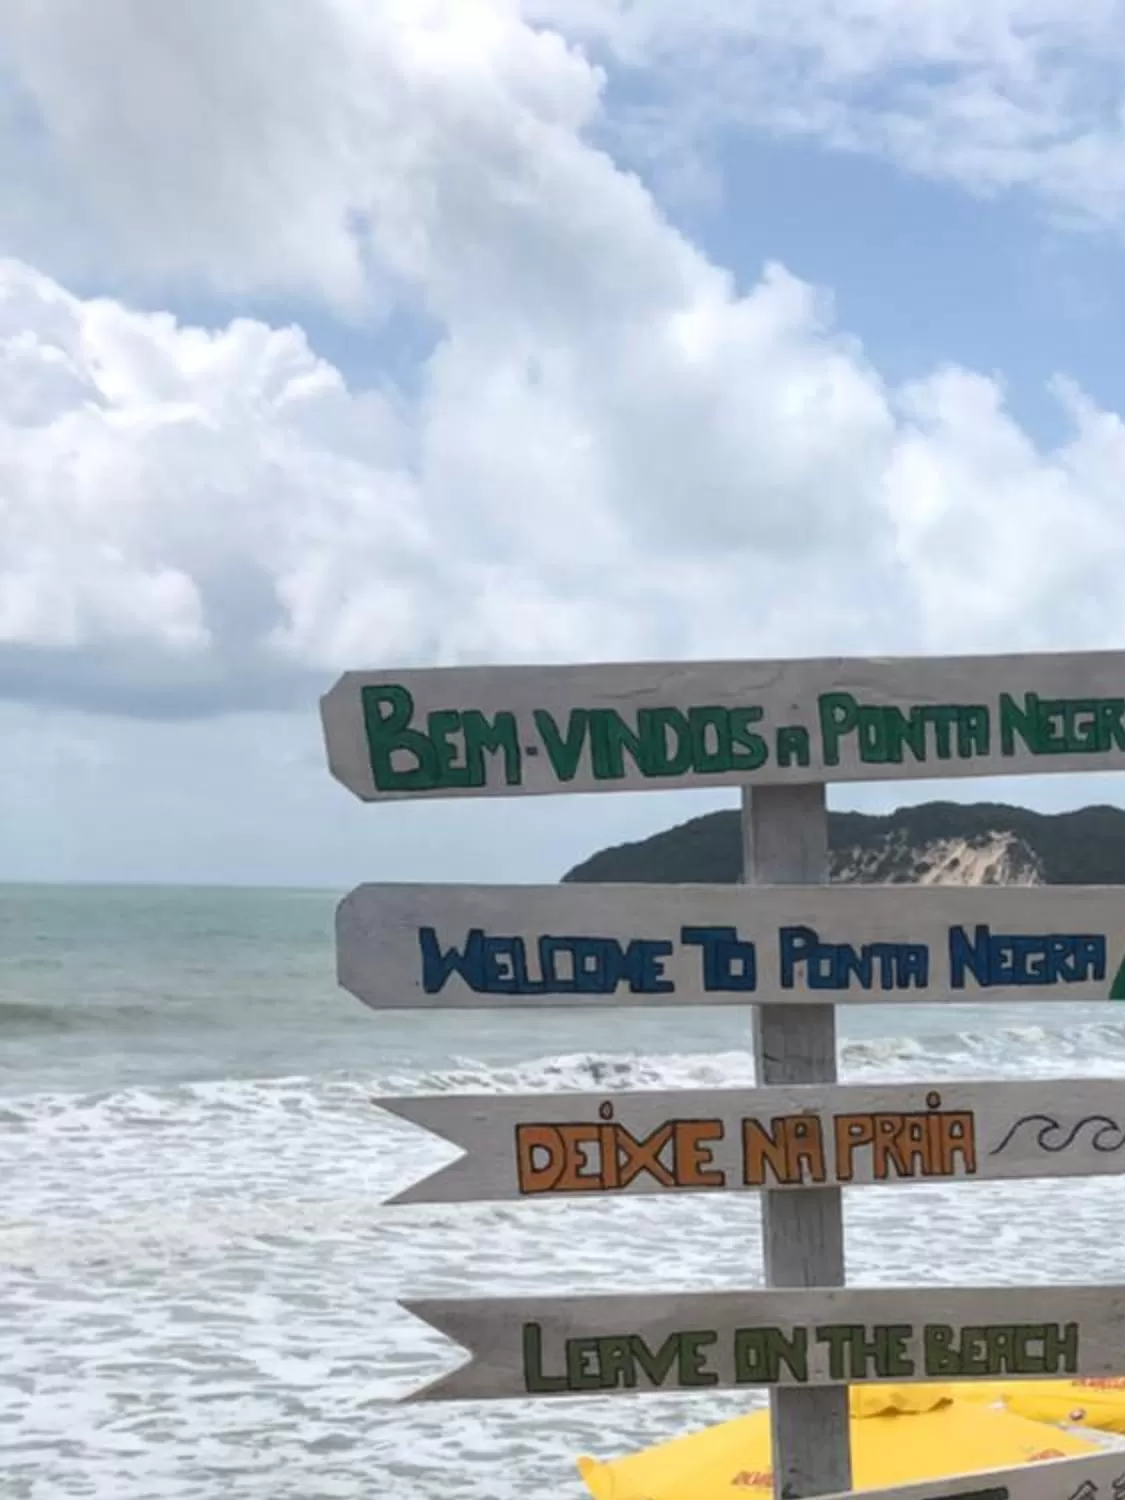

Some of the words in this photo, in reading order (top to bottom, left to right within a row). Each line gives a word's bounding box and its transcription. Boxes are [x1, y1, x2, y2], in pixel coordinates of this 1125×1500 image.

[362, 684, 769, 792] BEM-VINDOS
[819, 691, 988, 767] PONTA
[418, 926, 673, 994] WELCOME
[682, 926, 757, 992] TO
[779, 926, 930, 991] PONTA
[950, 925, 1107, 988] NEGRA
[743, 1113, 825, 1185] NA
[522, 1322, 719, 1393] LEAVE
[734, 1327, 808, 1383] ON
[816, 1324, 916, 1380] THE
[924, 1322, 1080, 1377] BEACH
